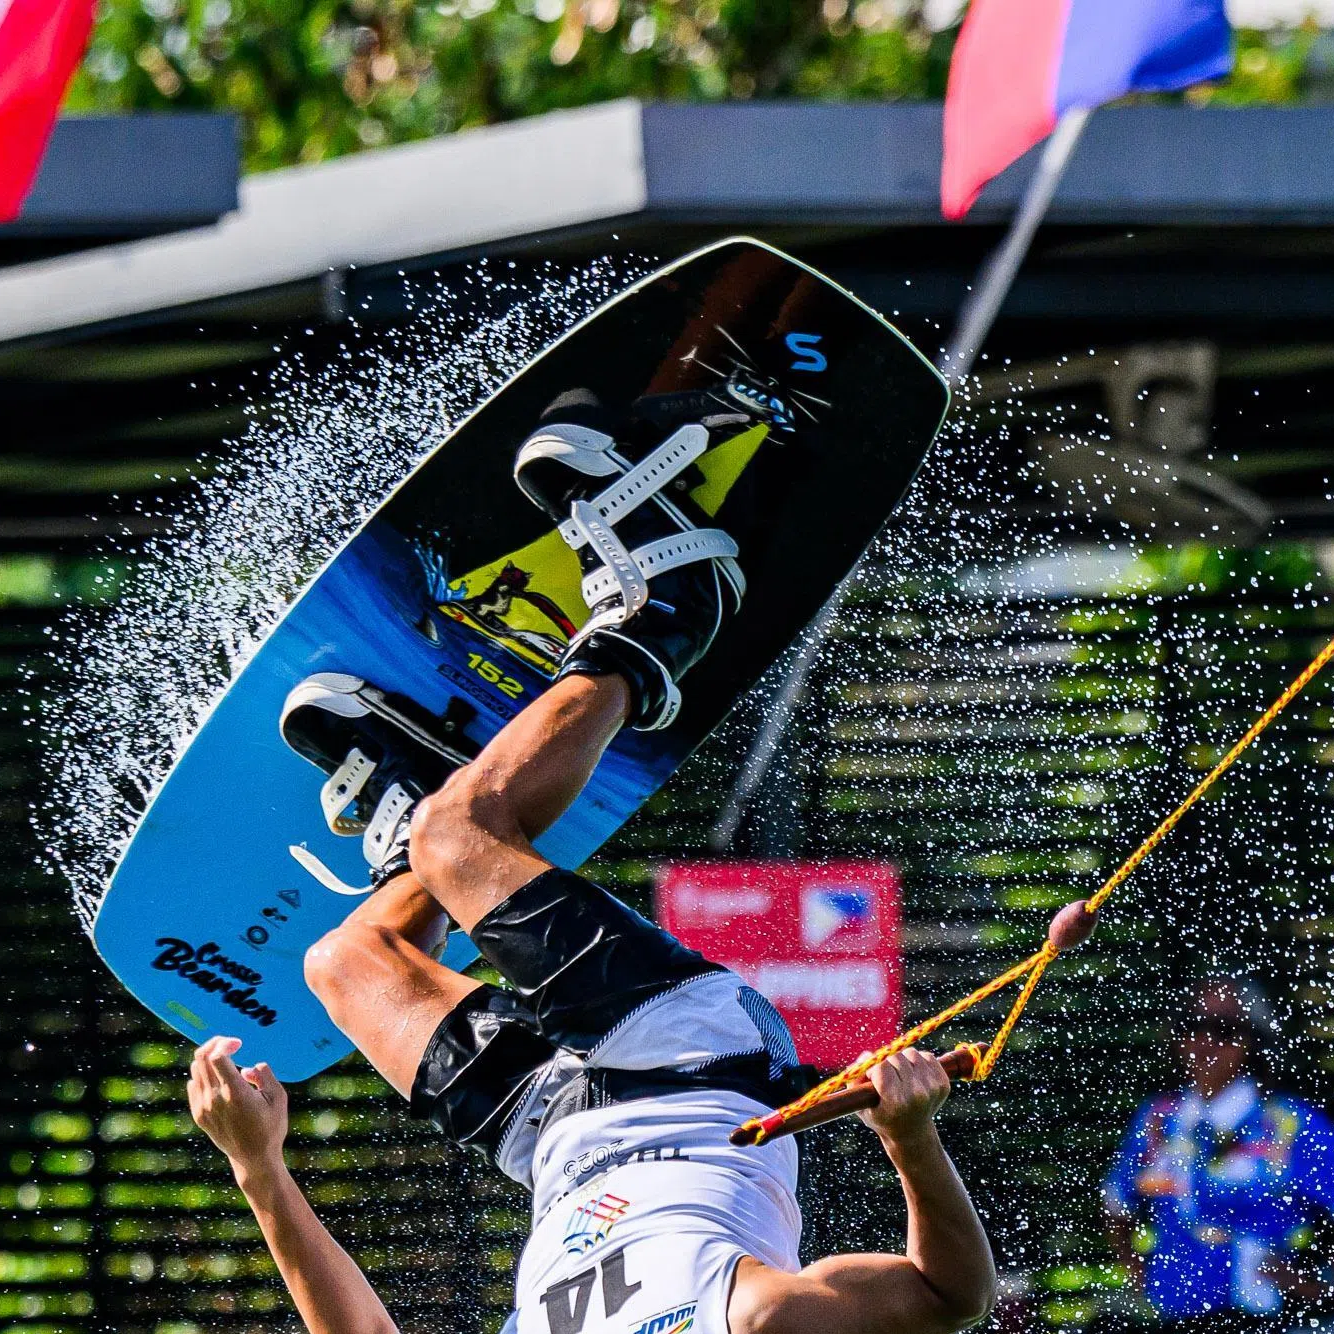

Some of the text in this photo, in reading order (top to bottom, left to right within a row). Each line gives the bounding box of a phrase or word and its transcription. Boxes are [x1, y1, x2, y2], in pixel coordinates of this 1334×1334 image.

[785, 333, 827, 371] S
[440, 665, 515, 719] SLINGSHOT
[468, 652, 524, 699] 152
[563, 1138, 624, 1184] 2025
